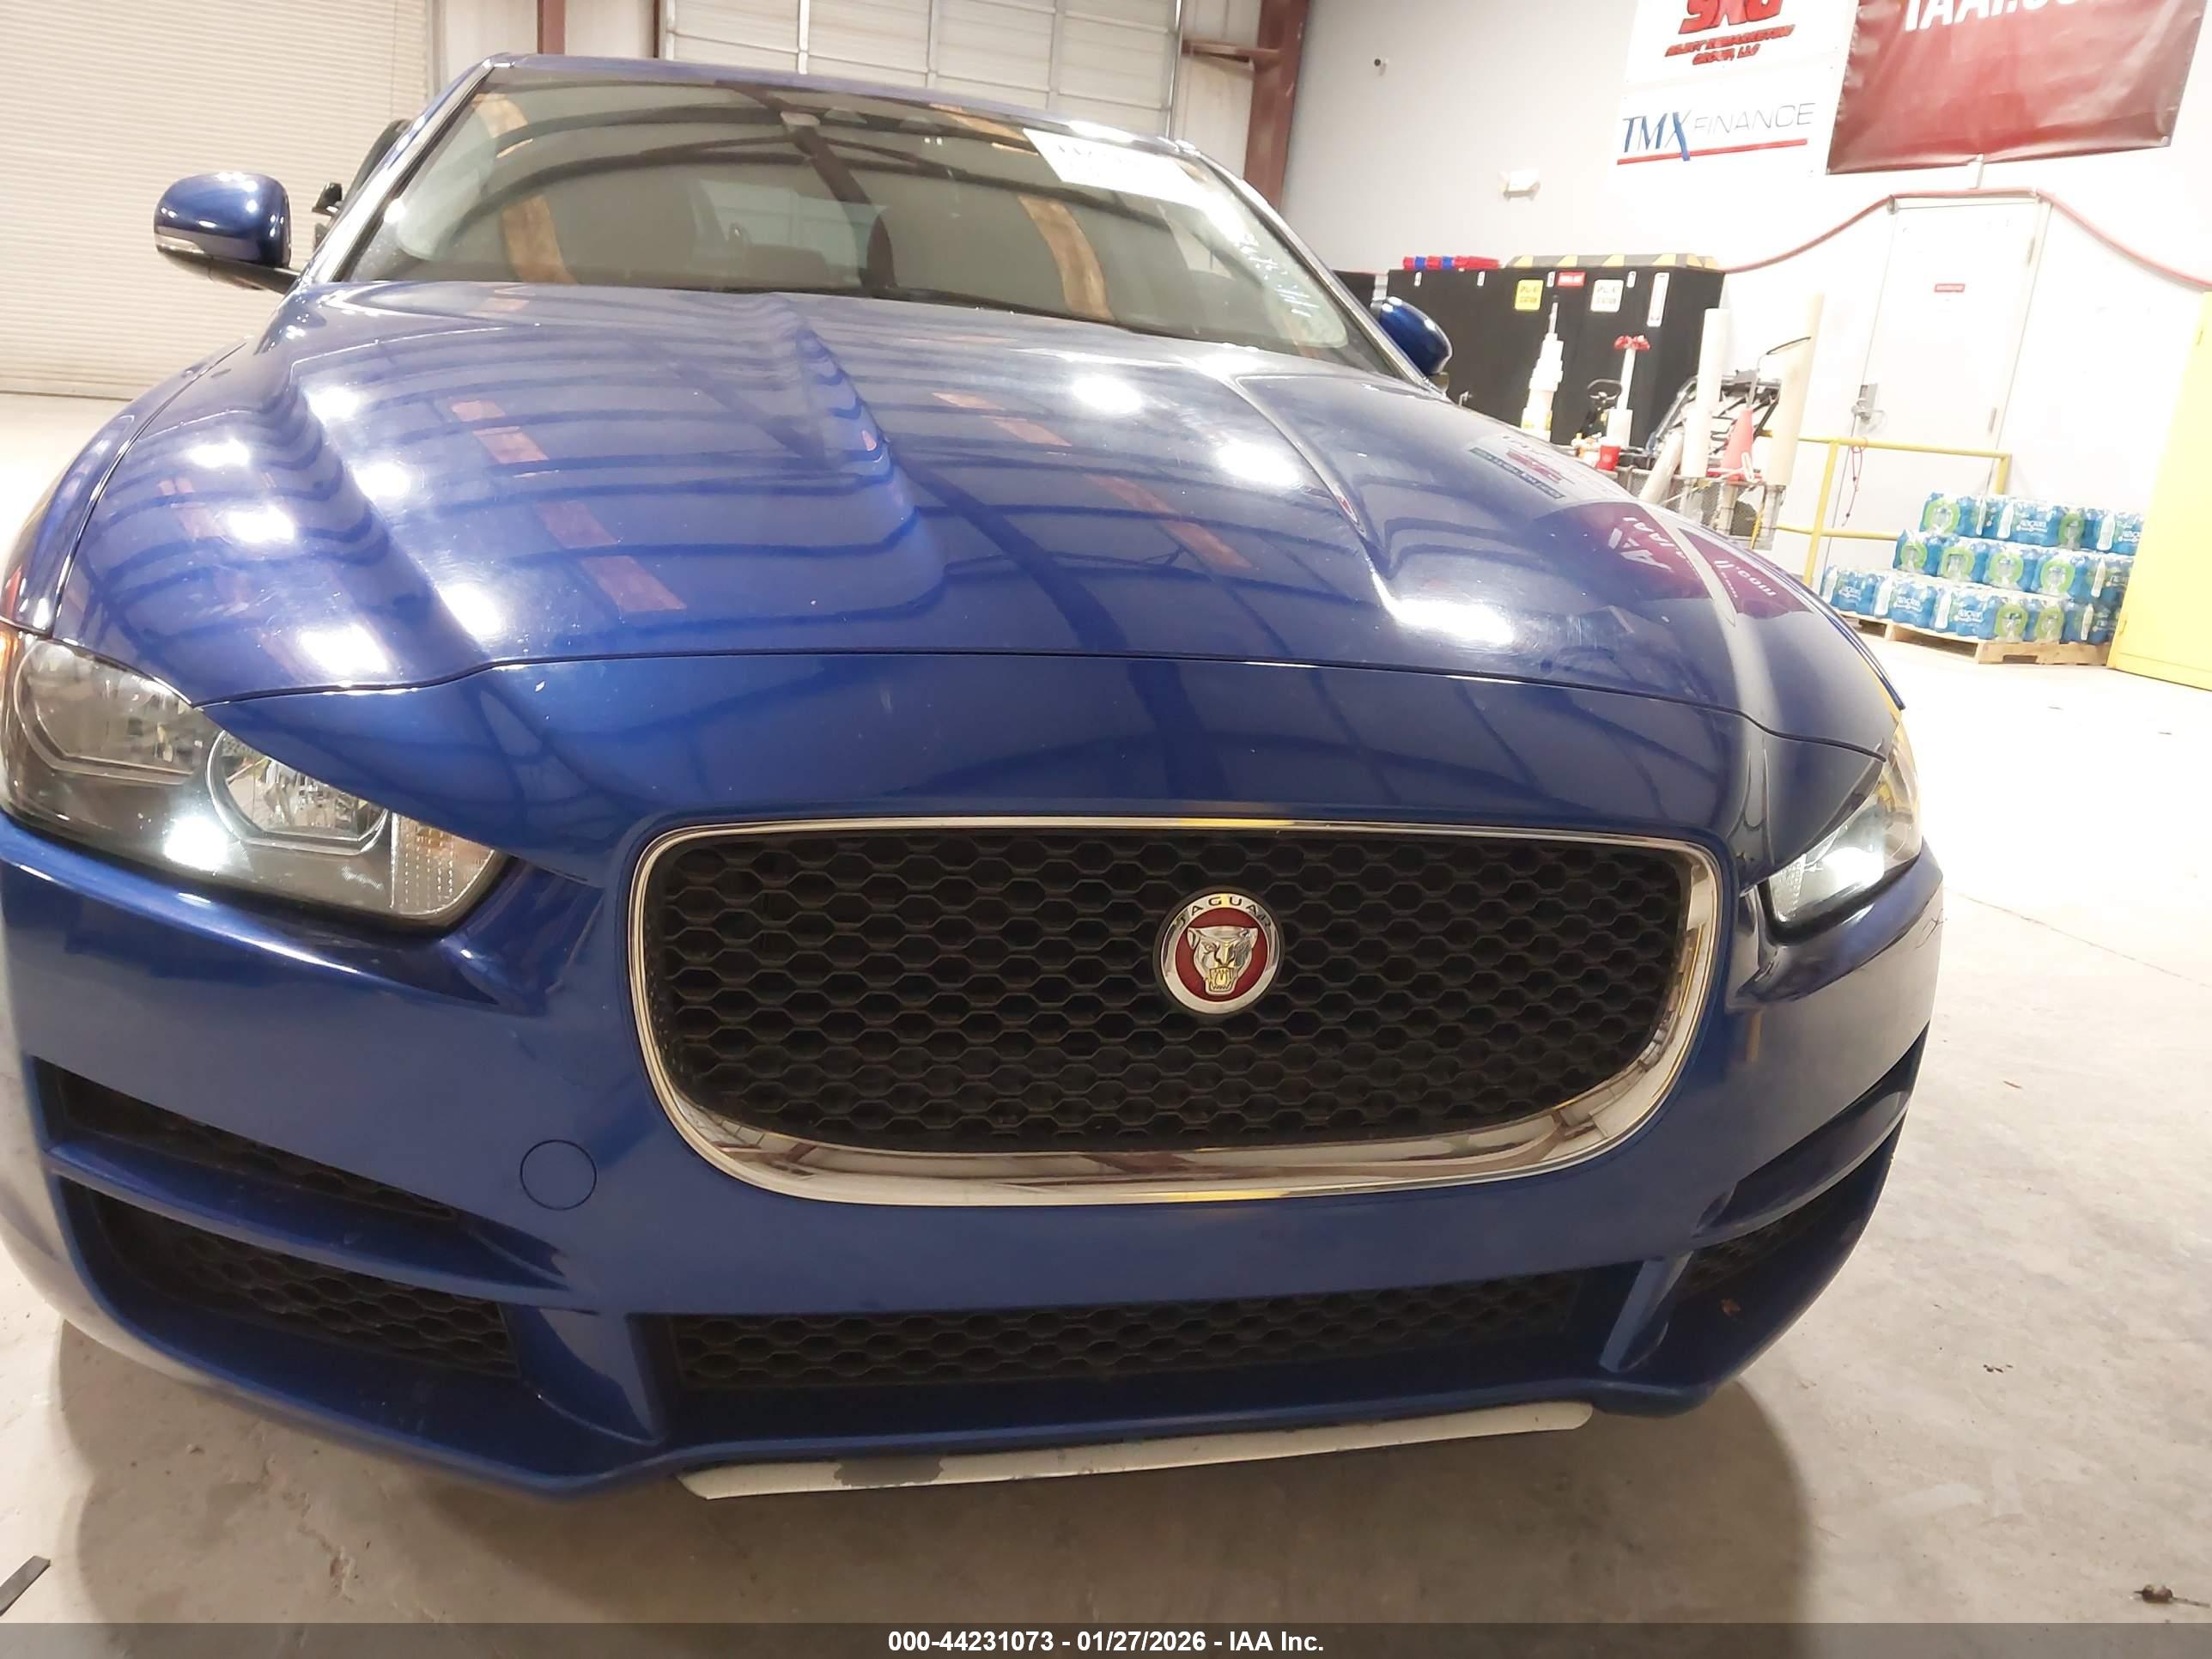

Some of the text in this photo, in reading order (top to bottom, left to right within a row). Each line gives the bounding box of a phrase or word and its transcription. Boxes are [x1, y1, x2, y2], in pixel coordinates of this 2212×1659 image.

[1622, 102, 1816, 161] TMX FINANCE
[1174, 895, 1272, 929] JAGUAR
